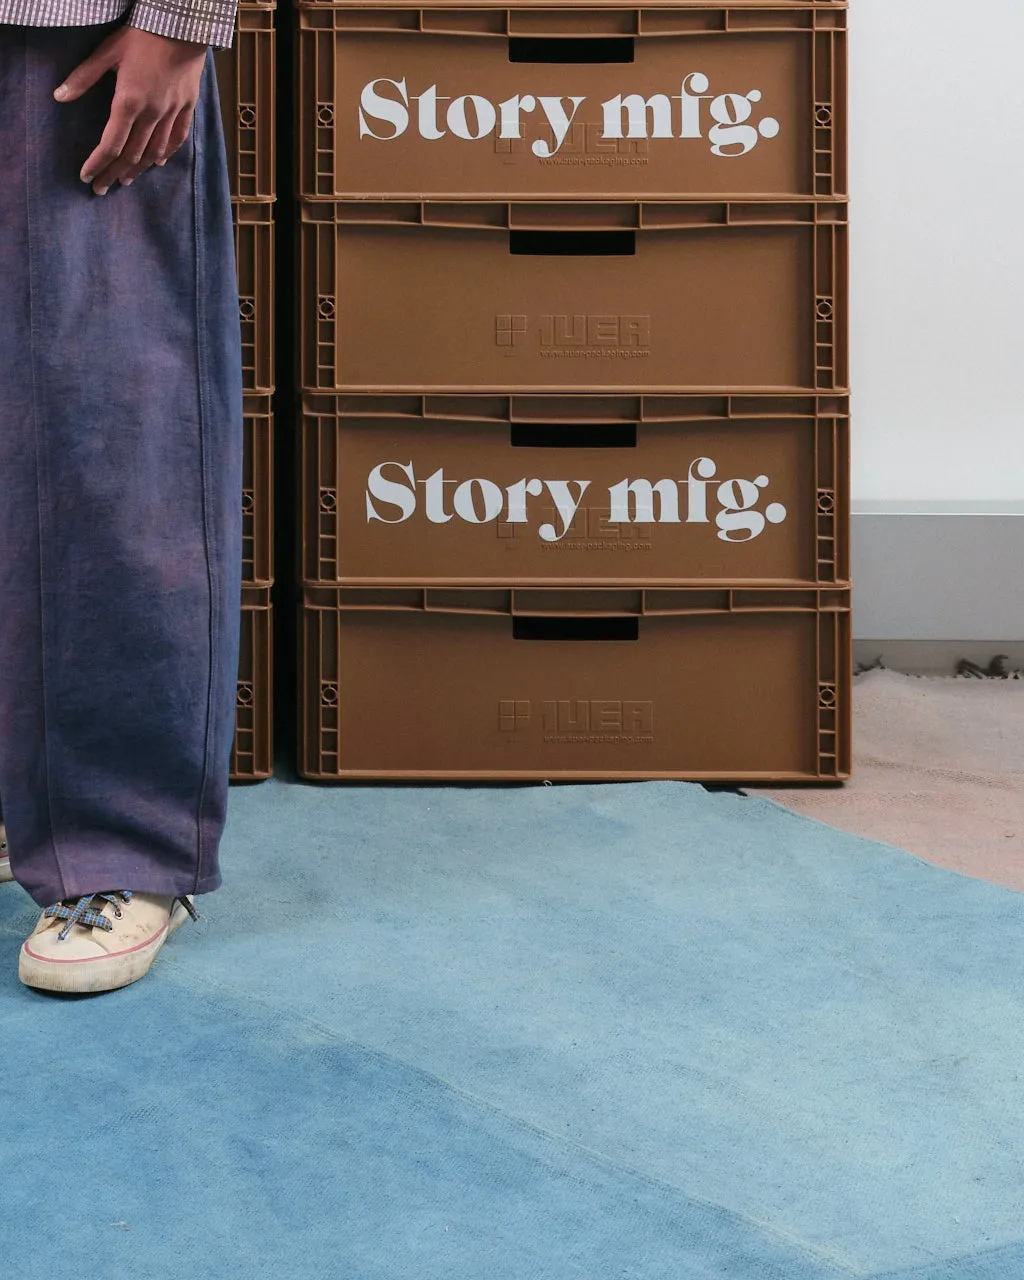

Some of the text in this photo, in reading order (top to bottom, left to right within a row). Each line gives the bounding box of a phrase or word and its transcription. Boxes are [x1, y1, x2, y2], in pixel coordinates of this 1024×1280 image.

[359, 72, 779, 157] Story mfg.
[366, 458, 786, 542] Story mfg.
